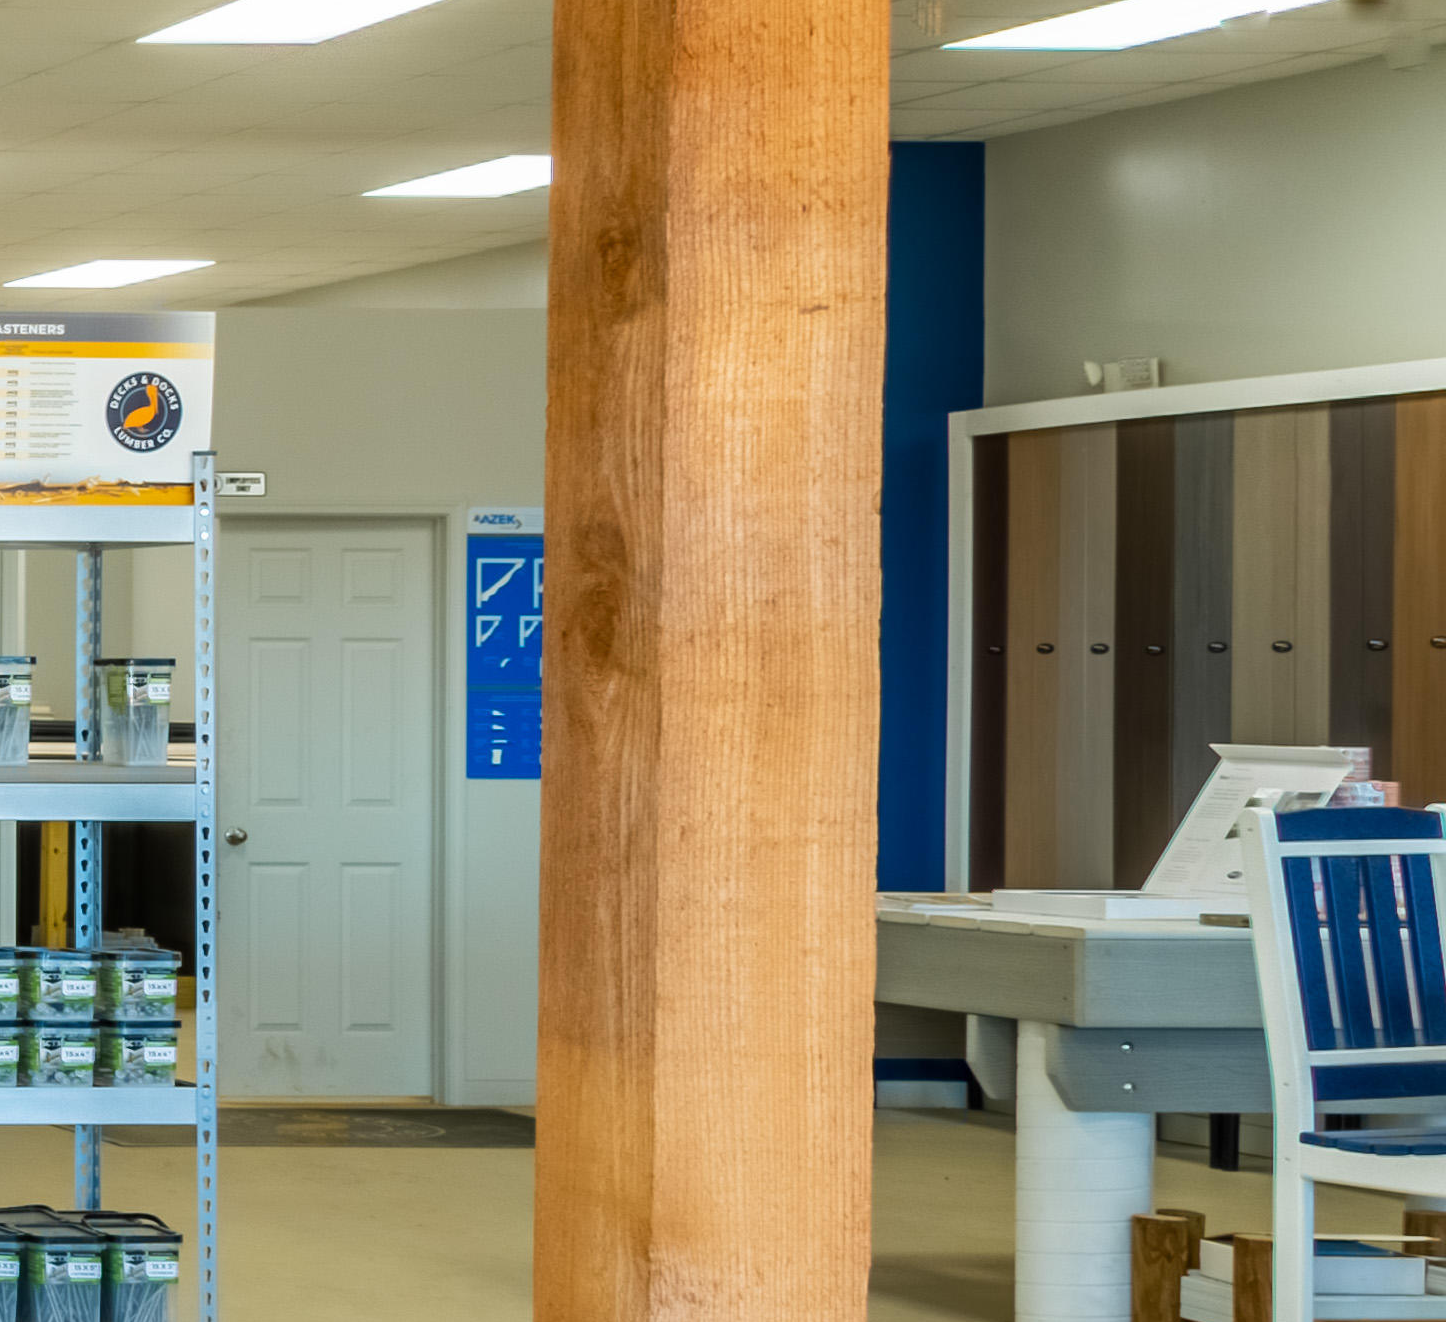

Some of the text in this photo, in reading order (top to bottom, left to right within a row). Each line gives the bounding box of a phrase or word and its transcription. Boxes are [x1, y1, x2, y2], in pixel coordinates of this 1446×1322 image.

[109, 376, 138, 410] DECKS
[151, 376, 179, 411] DOCKS
[113, 426, 155, 450] LUMBER
[479, 513, 516, 525] AZEK
